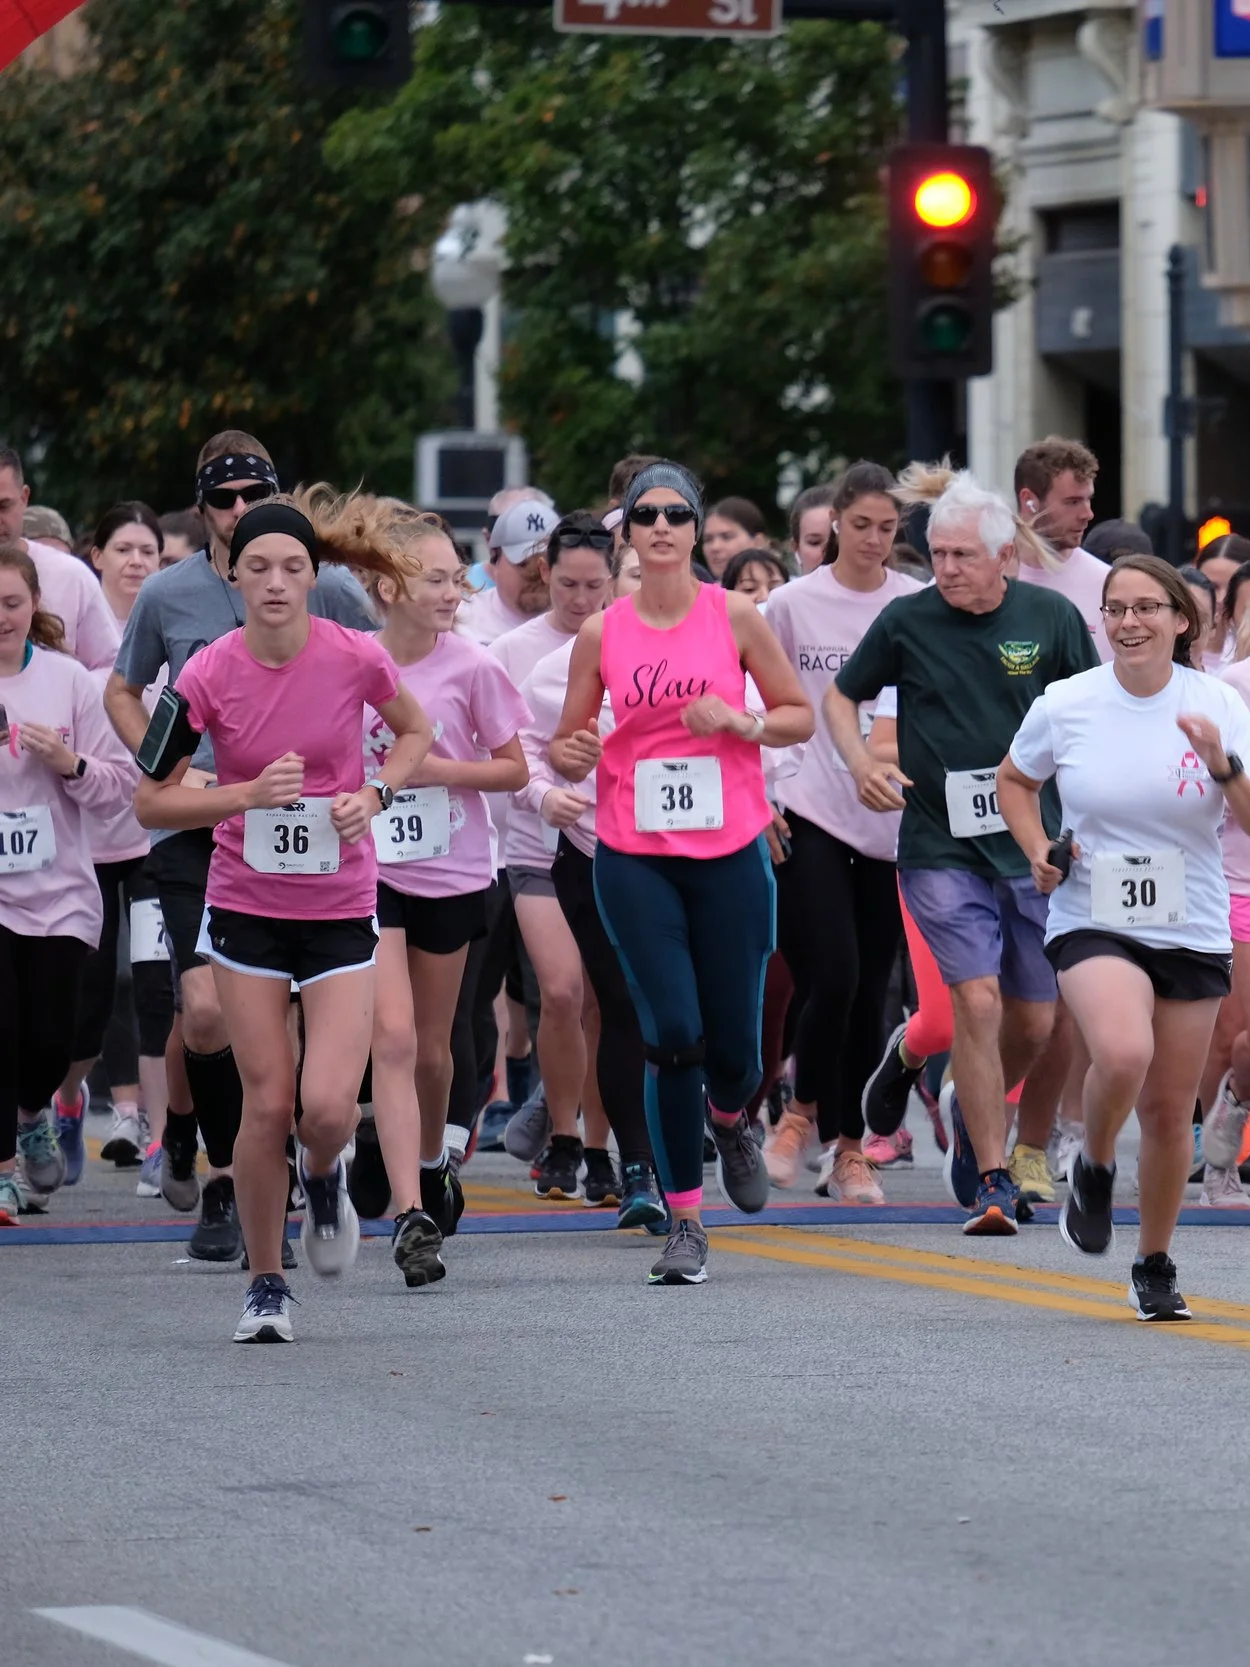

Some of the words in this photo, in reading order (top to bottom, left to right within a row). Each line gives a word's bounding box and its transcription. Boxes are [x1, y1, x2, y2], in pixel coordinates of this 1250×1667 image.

[660, 783, 694, 812] 38
[972, 790, 1001, 819] 90
[273, 824, 309, 855] 36
[389, 814, 423, 843] 39
[1121, 878, 1157, 908] 30
